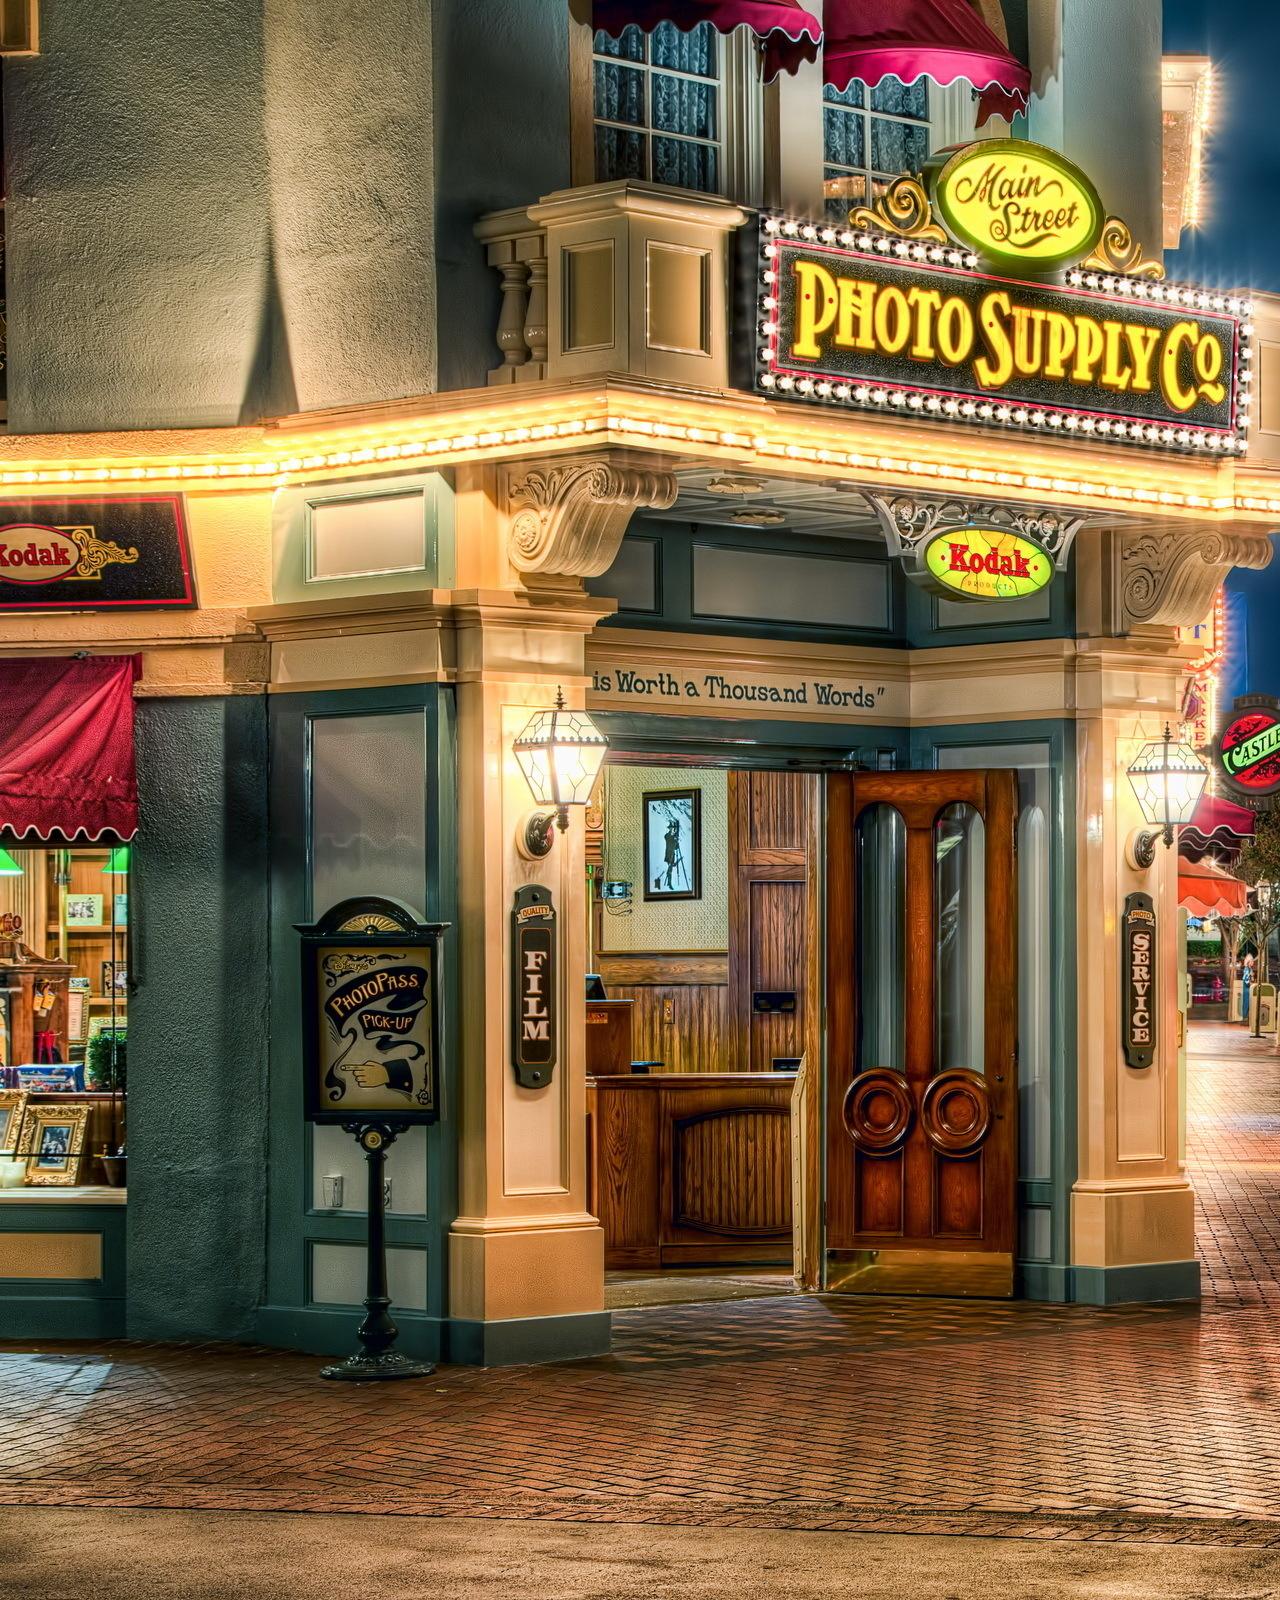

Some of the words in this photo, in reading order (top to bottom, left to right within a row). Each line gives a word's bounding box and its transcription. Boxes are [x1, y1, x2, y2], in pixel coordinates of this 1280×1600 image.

[955, 163, 1064, 209] Main
[989, 202, 1079, 249] Street
[792, 260, 975, 365] PHOTO
[973, 290, 1161, 391] SUPPLY
[949, 543, 1030, 578] Kodak
[592, 670, 611, 691] is
[615, 669, 680, 696] Worth
[684, 680, 700, 698] a
[704, 675, 808, 704] Thousand
[522, 906, 549, 917] QUALITY
[1132, 910, 1151, 919] PHOTO
[330, 972, 419, 1017] PHOTOPASS
[522, 951, 549, 1041] FILM
[1132, 933, 1150, 1043] SERVICE
[362, 1014, 413, 1029] PICK-UP
